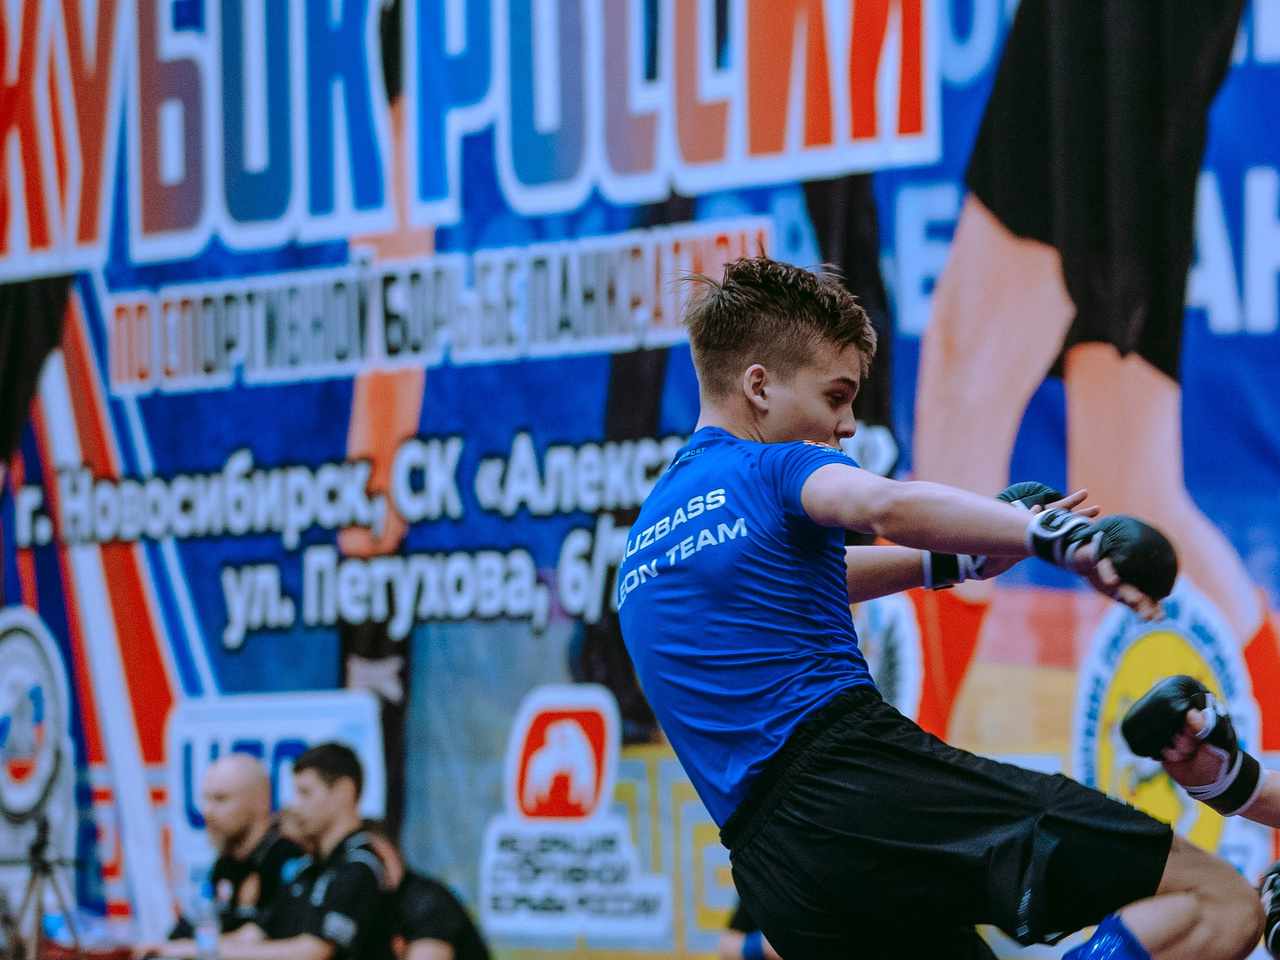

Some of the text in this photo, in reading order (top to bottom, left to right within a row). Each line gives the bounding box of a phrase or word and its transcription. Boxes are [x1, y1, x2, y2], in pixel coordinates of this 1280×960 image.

[16, 485, 52, 546] г.
[58, 450, 386, 550] Новосибирск,
[392, 437, 464, 524] СК
[665, 517, 748, 567] TEAM
[222, 563, 296, 650] ул.
[302, 542, 548, 642] Петухова,
